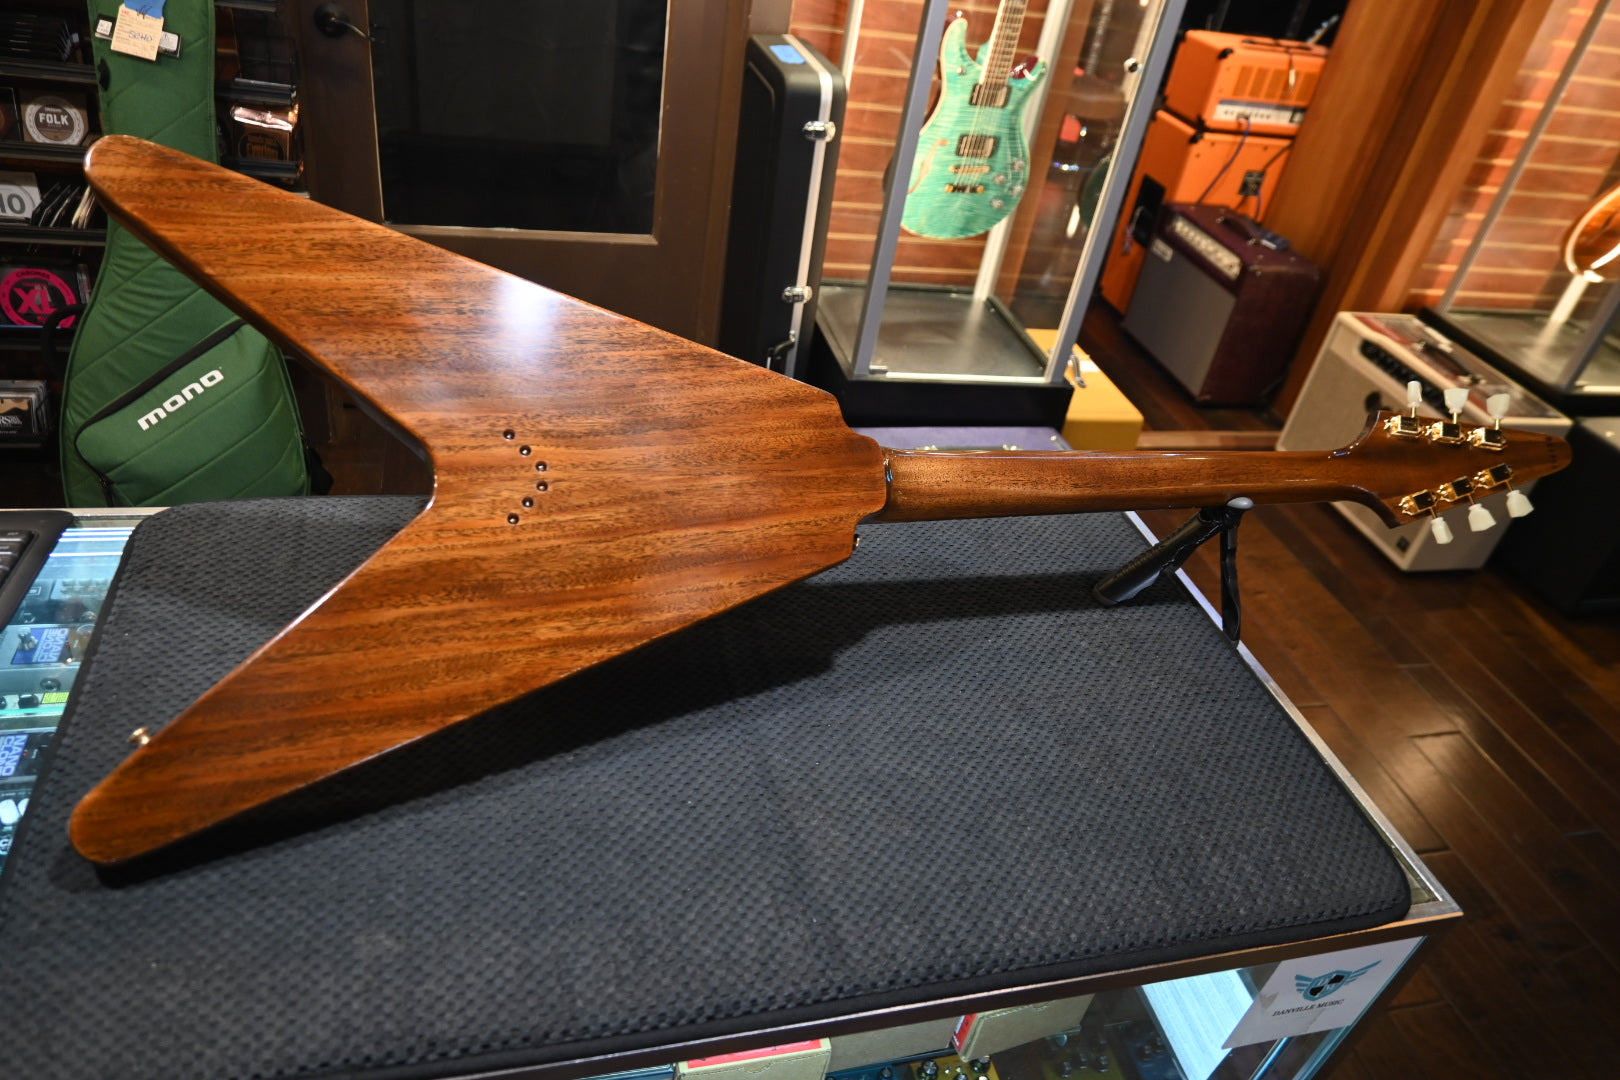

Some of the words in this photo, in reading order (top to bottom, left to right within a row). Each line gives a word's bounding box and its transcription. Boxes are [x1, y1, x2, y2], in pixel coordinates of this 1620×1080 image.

[39, 112, 69, 126] FOLK
[13, 287, 59, 314] XL
[137, 369, 224, 431] mono
[1272, 1004, 1315, 1017] DANVILLE
